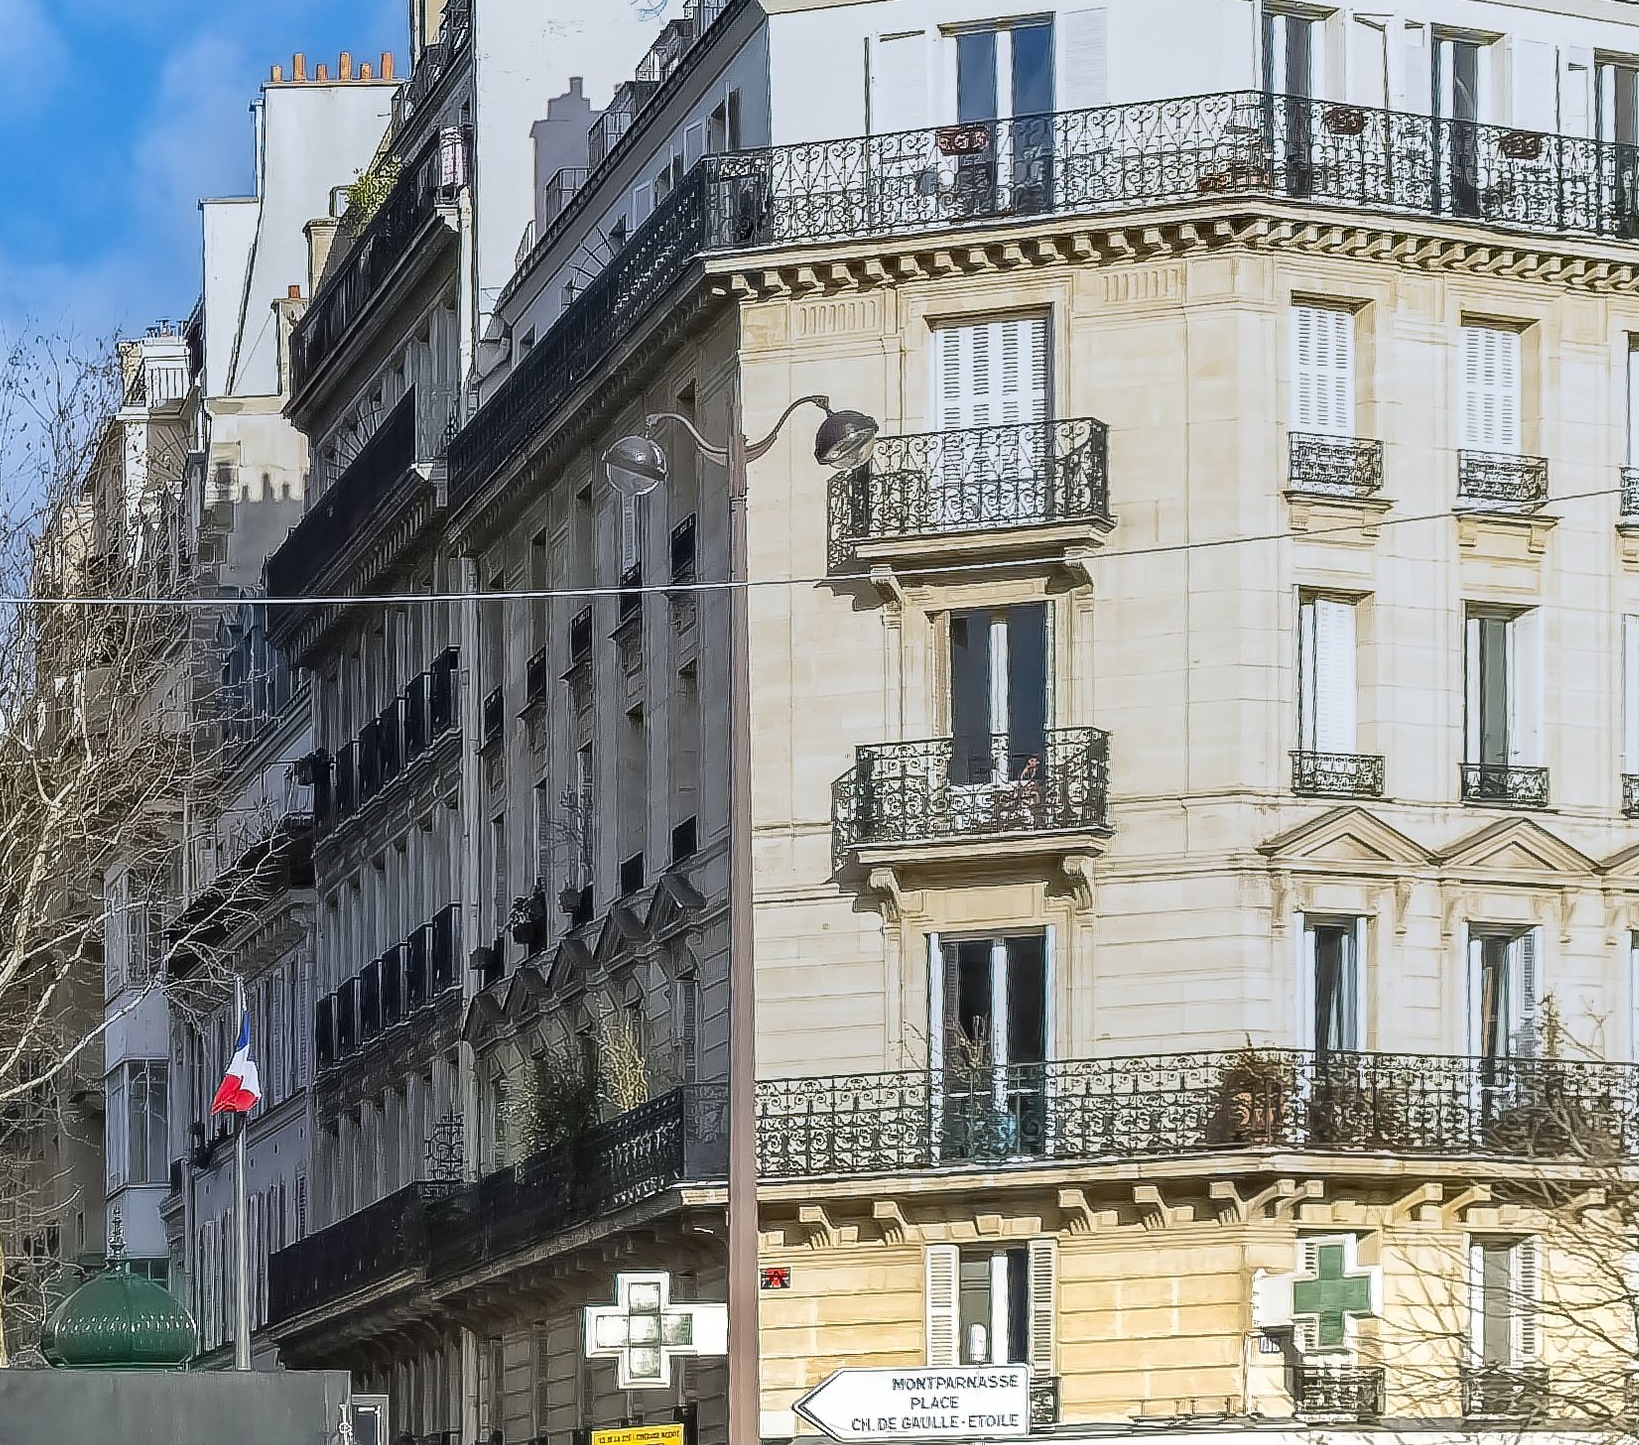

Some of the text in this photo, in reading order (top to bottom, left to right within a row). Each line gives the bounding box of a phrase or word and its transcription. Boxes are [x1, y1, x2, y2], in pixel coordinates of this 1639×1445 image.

[892, 1374, 1019, 1391] MONTPARNASSE
[910, 1395, 959, 1410] PLACE
[901, 1415, 959, 1430] GAULLE
[968, 1414, 1019, 1428] ETOILE
